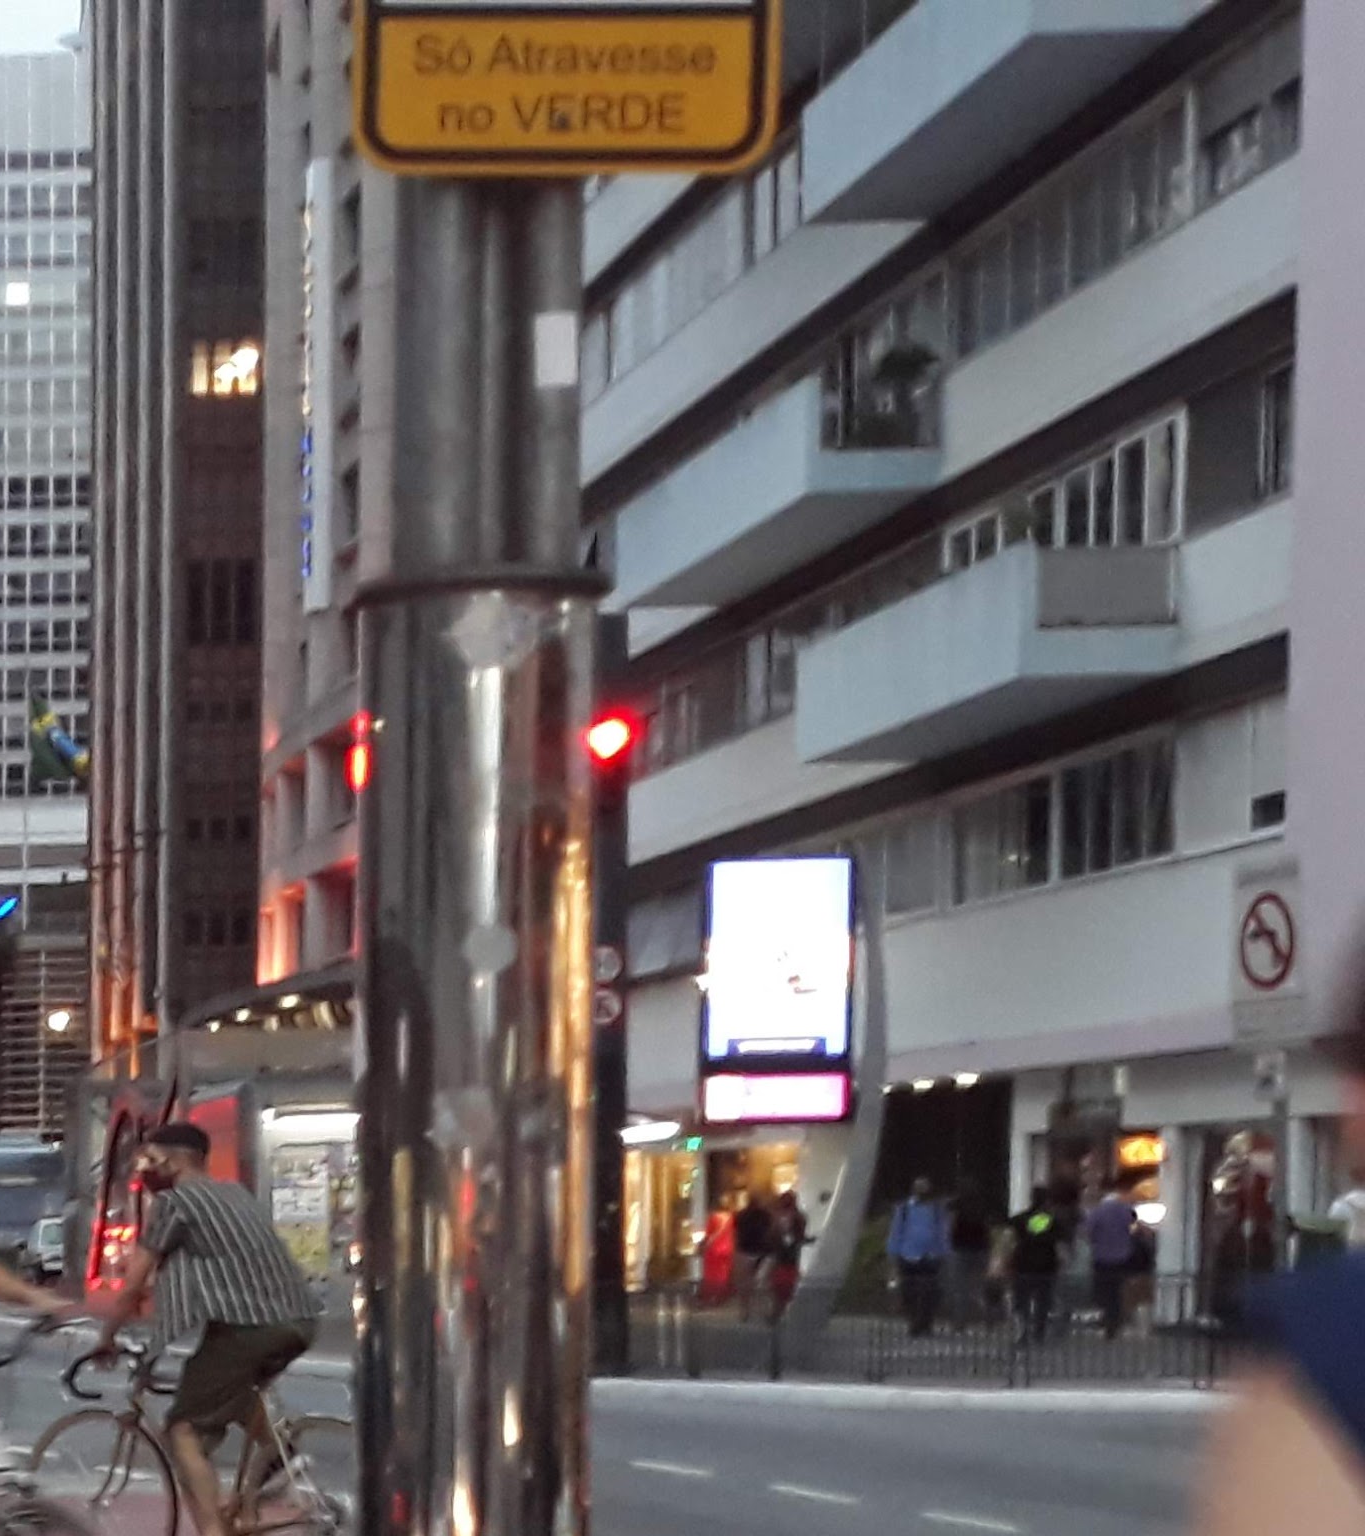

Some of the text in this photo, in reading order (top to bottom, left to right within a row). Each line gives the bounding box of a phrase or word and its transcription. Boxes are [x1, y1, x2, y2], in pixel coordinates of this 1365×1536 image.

[414, 33, 716, 75] Só Atravesse
[438, 93, 686, 133] no VERDE
